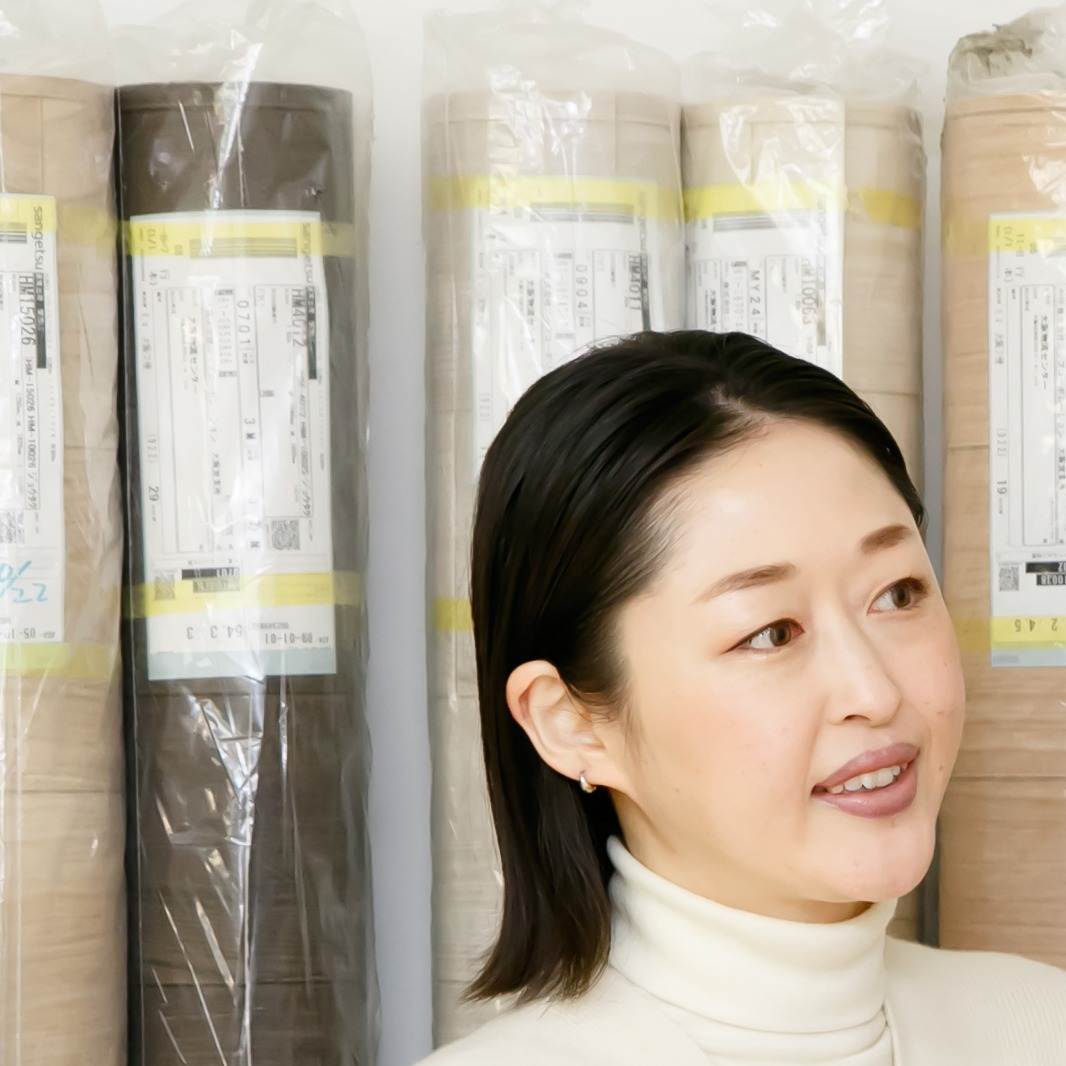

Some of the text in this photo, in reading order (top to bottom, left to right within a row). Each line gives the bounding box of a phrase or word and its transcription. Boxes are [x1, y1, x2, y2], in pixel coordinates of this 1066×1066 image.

[31, 206, 47, 271] sangetsu
[302, 222, 315, 284] sangetsu
[19, 275, 36, 345] HM15026
[575, 265, 588, 309] 0904
[749, 270, 760, 315] MY24
